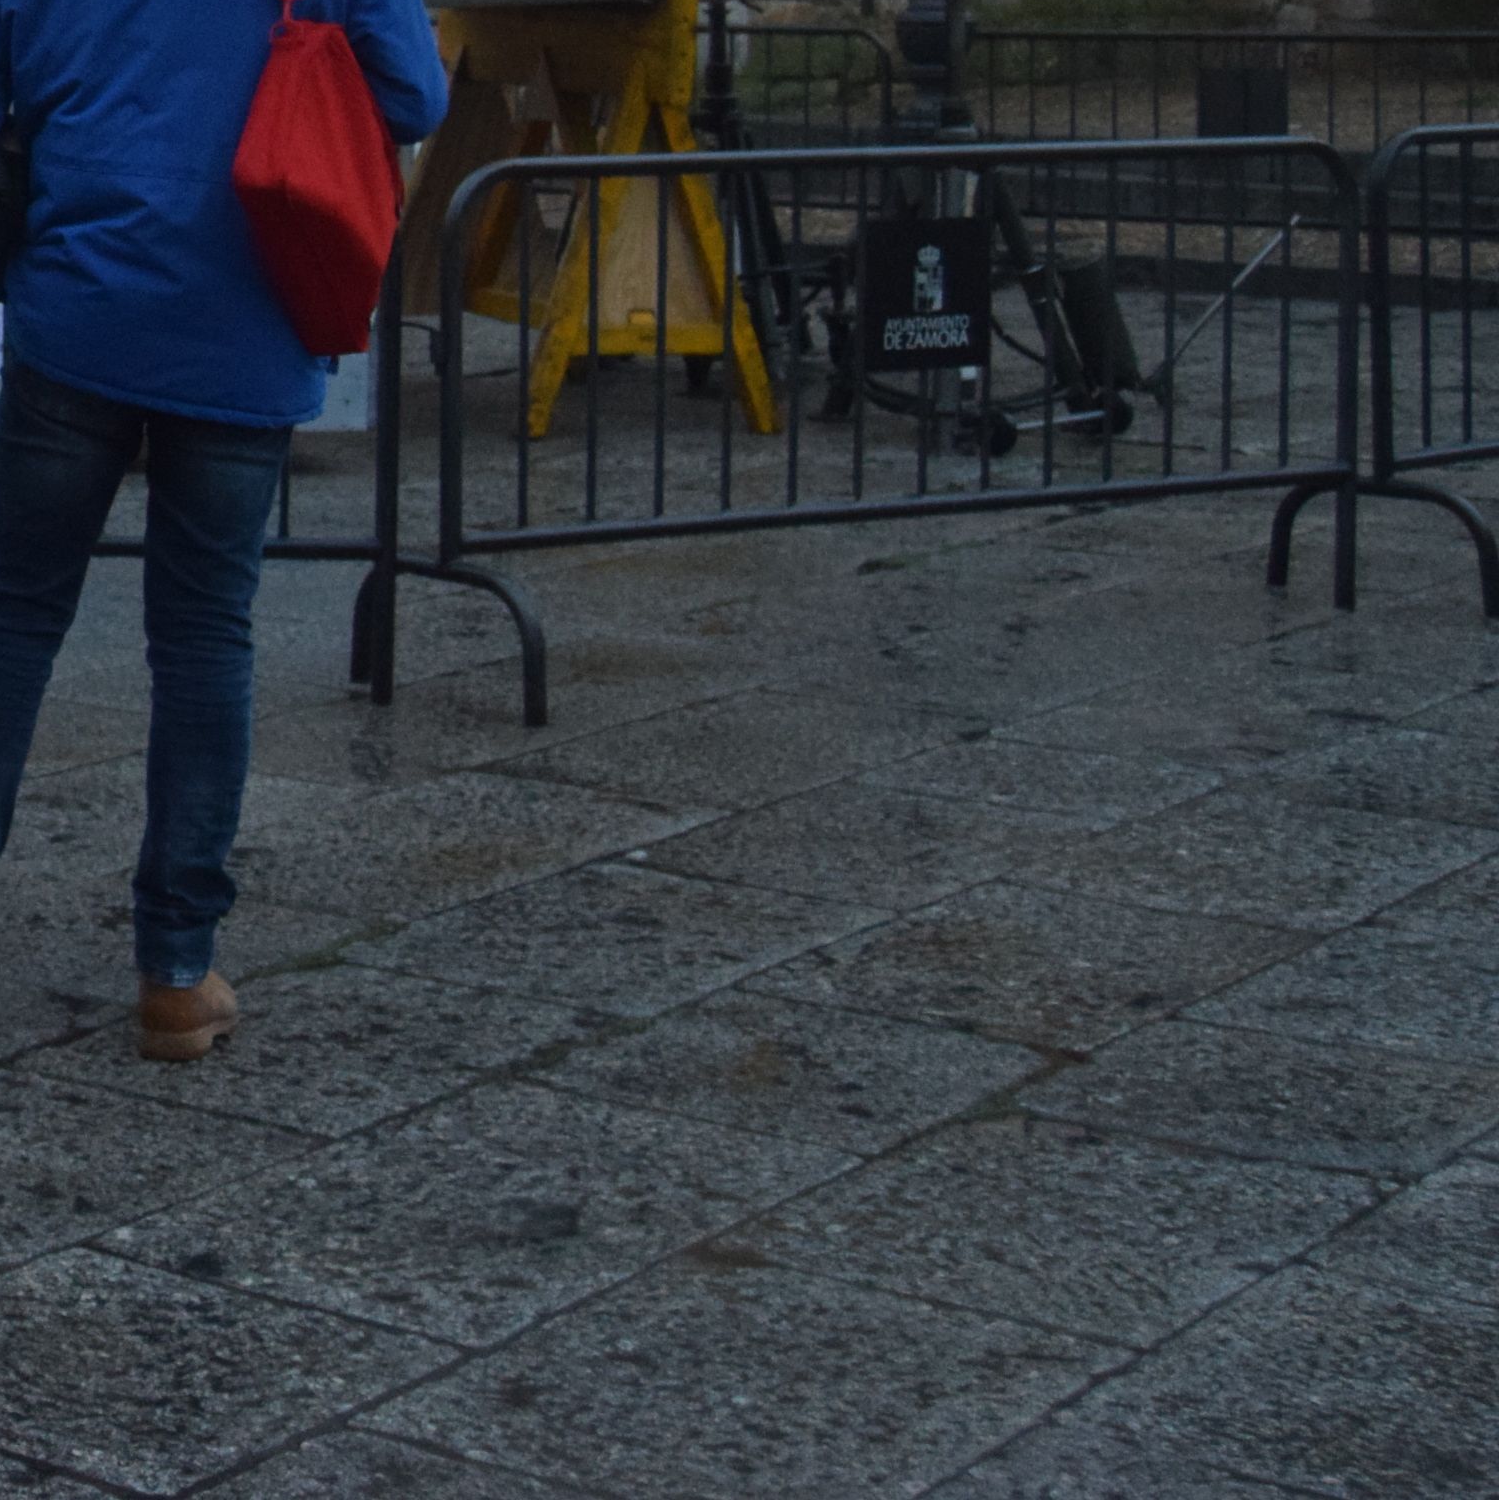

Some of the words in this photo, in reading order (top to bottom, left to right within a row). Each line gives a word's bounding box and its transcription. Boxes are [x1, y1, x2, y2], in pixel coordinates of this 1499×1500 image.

[885, 315, 970, 332] AYUNTAMIENTO
[884, 331, 903, 350] DE
[906, 330, 970, 349] ZAMORA
